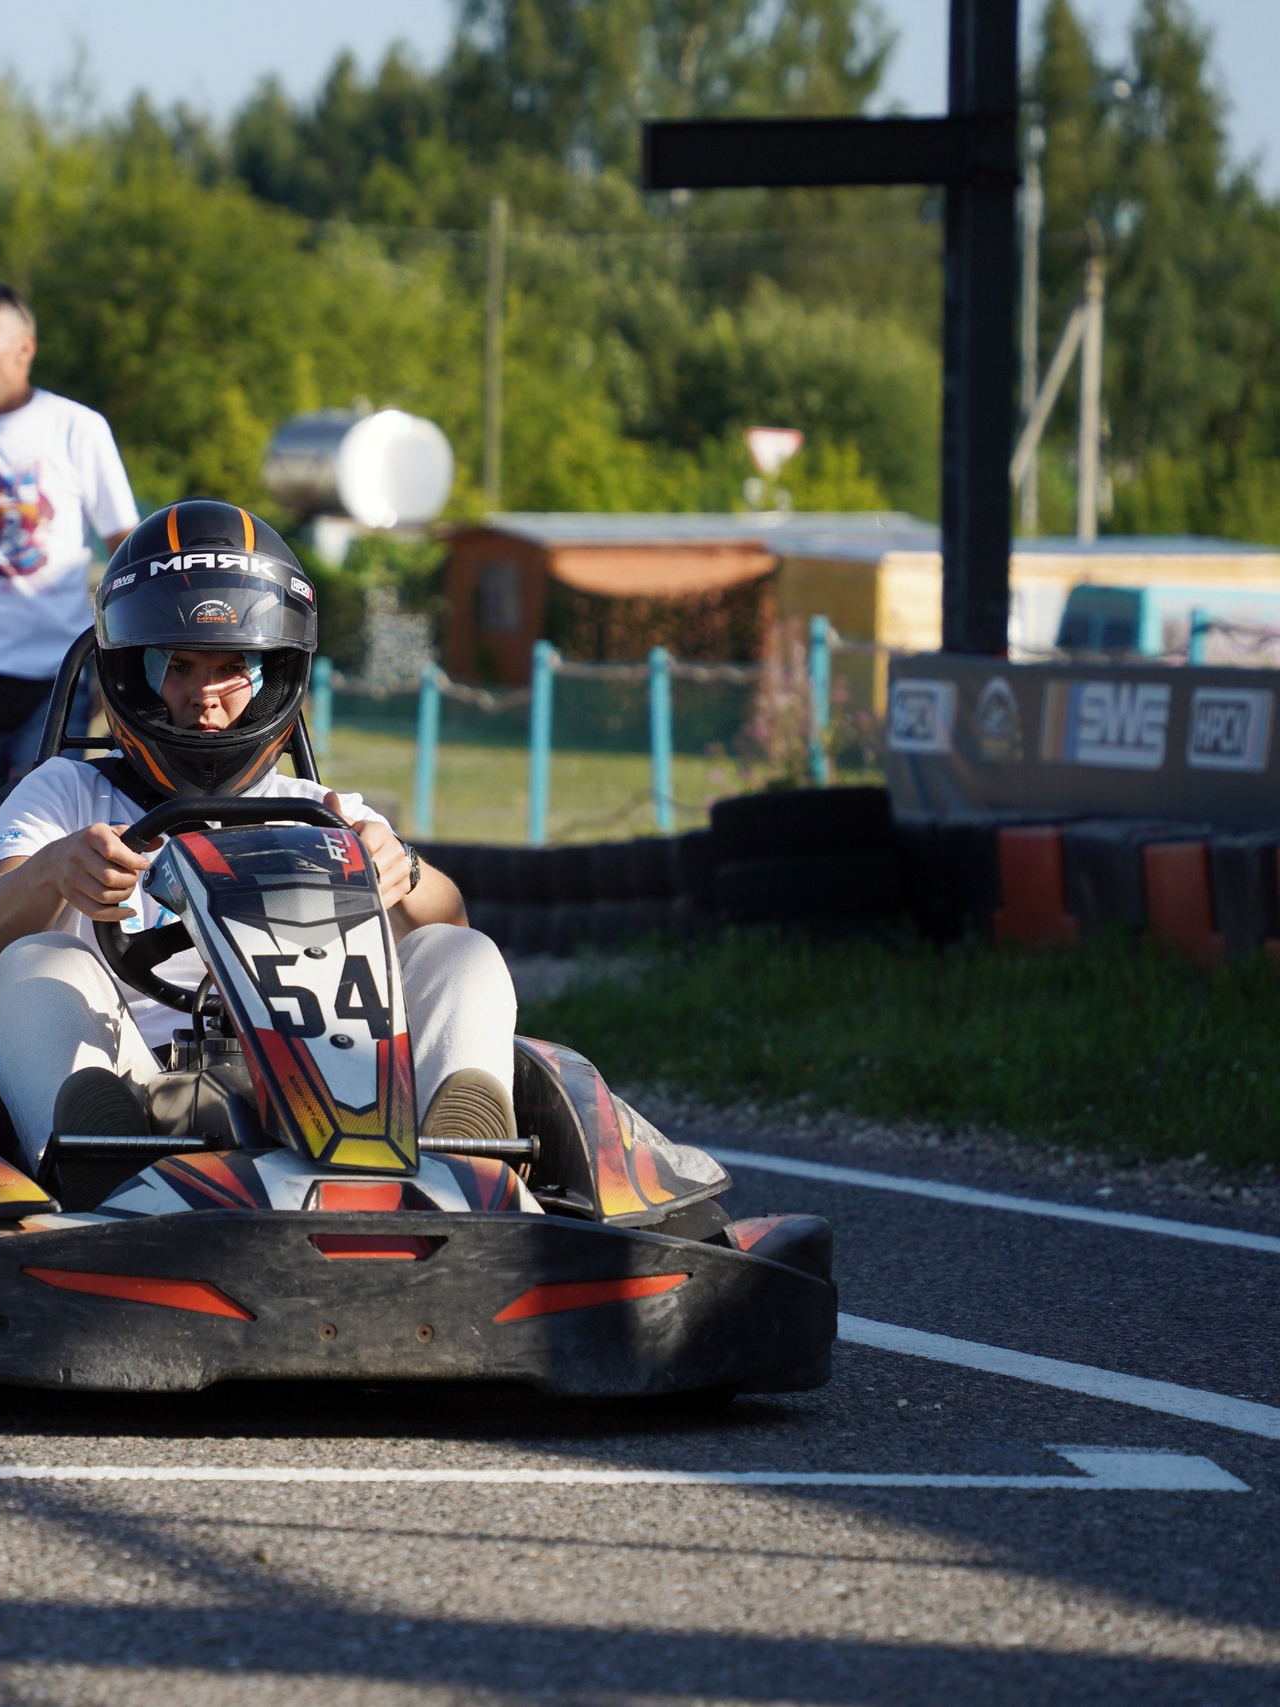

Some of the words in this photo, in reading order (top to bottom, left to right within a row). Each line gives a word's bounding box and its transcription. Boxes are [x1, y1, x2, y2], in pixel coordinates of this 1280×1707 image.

[150, 553, 277, 579] МАЯК
[1078, 682, 1172, 754] SWS
[251, 954, 390, 1040] 54
